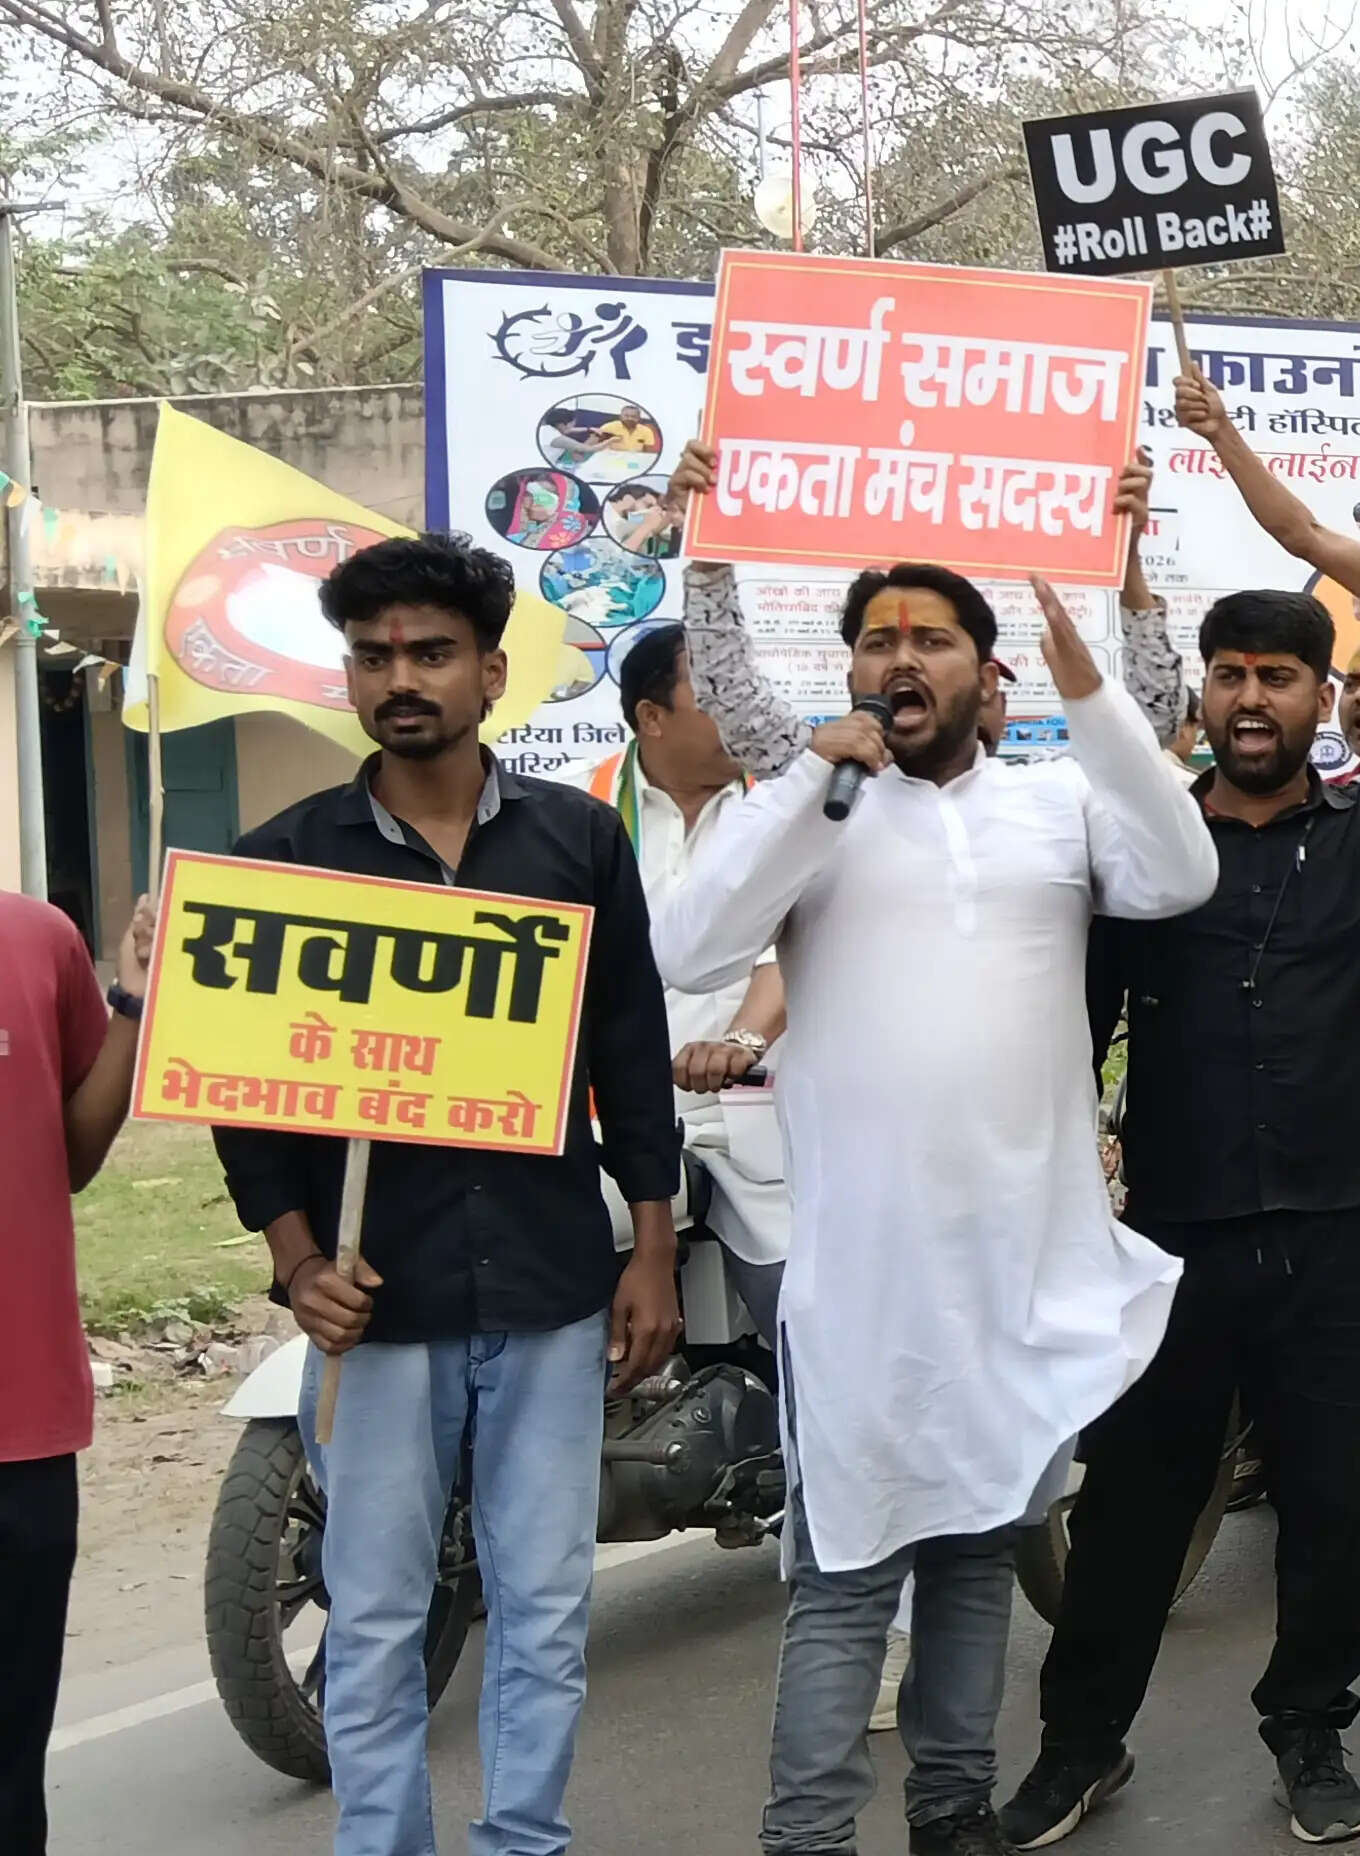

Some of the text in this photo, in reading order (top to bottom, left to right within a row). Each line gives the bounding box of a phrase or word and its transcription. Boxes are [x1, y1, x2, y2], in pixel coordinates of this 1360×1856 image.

[1051, 112, 1252, 204] UGC
[1053, 199, 1272, 266] #Roll Back#
[728, 297, 895, 401] स्वर्ण
[900, 332, 1129, 422] समाज
[717, 419, 1113, 537] एकता मंच सदस्य
[573, 723, 628, 744] जिले
[182, 900, 571, 1024] सवर्णों
[289, 1011, 442, 1076] के साथ
[162, 1057, 542, 1138] भेदभाव बंद करो
